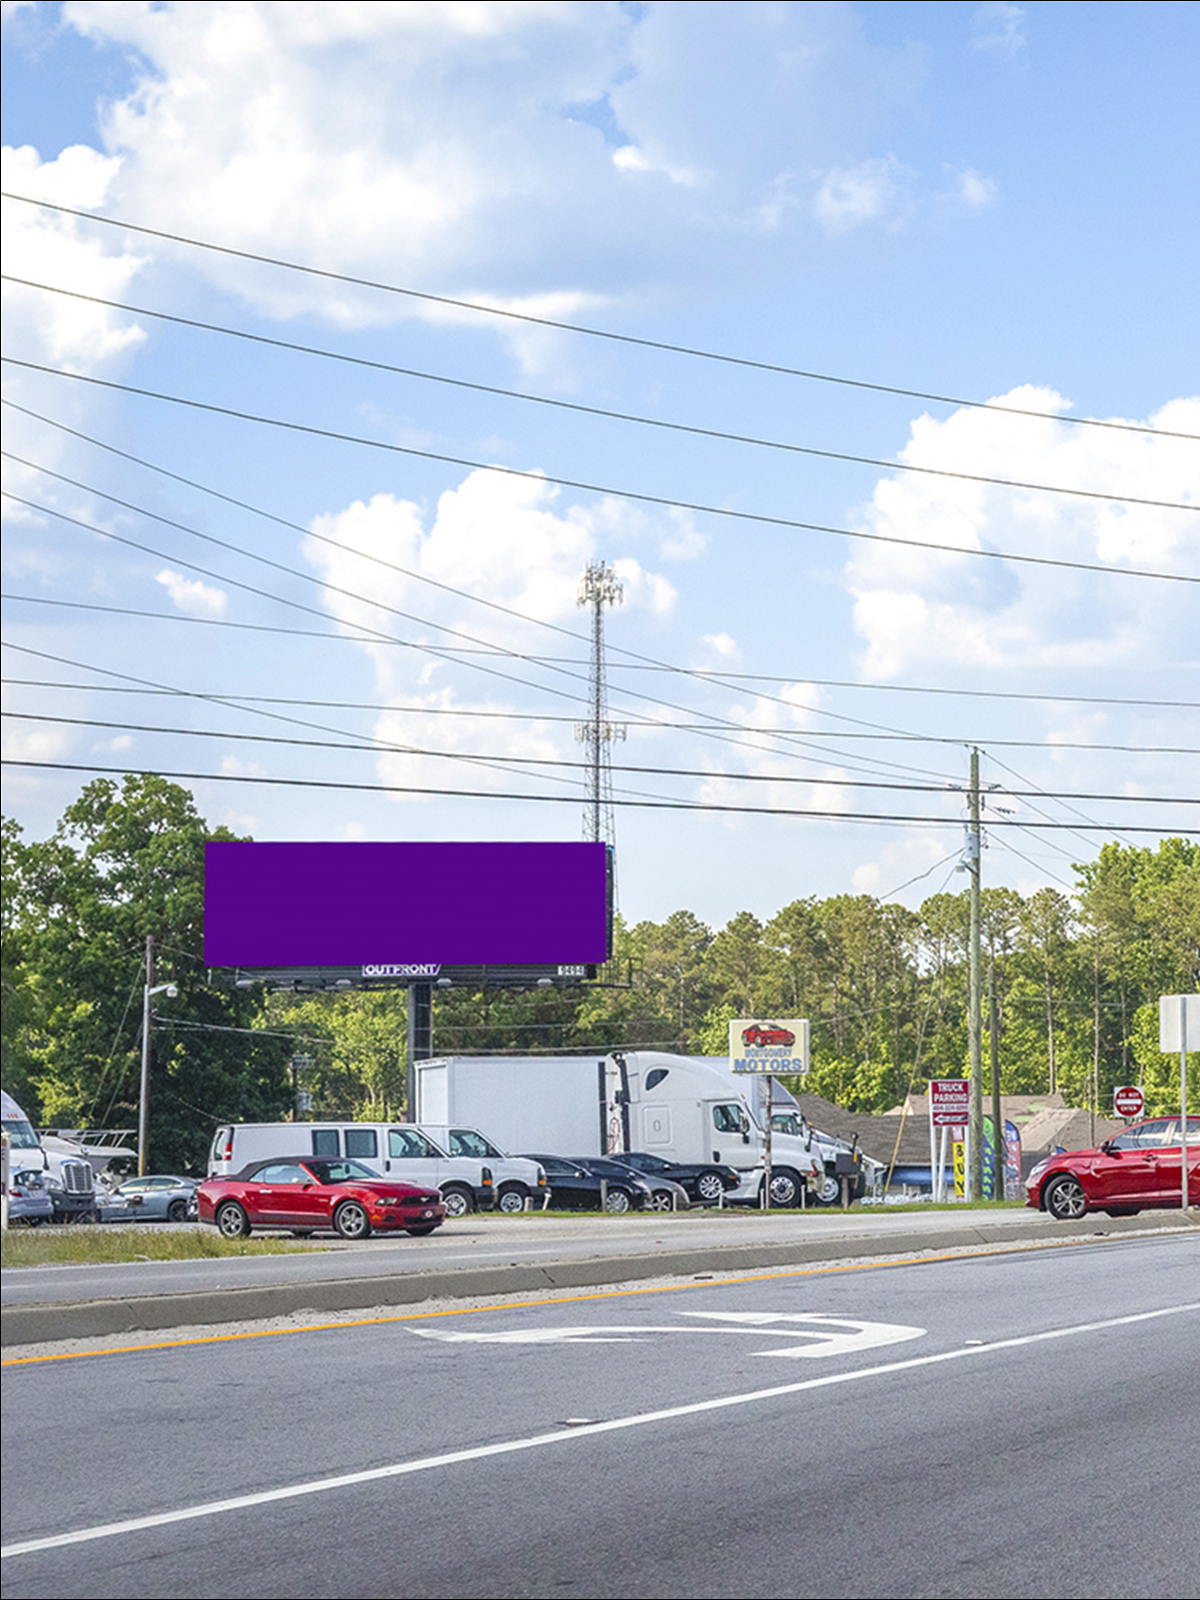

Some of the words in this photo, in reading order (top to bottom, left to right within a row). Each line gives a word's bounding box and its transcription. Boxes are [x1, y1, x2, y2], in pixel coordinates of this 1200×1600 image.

[365, 964, 437, 975] OUTFRONT
[744, 1047, 792, 1058] MONTGOMERY
[734, 1058, 802, 1071] MOTORS
[938, 1083, 963, 1092] TRUCK
[934, 1094, 967, 1102] PARKING
